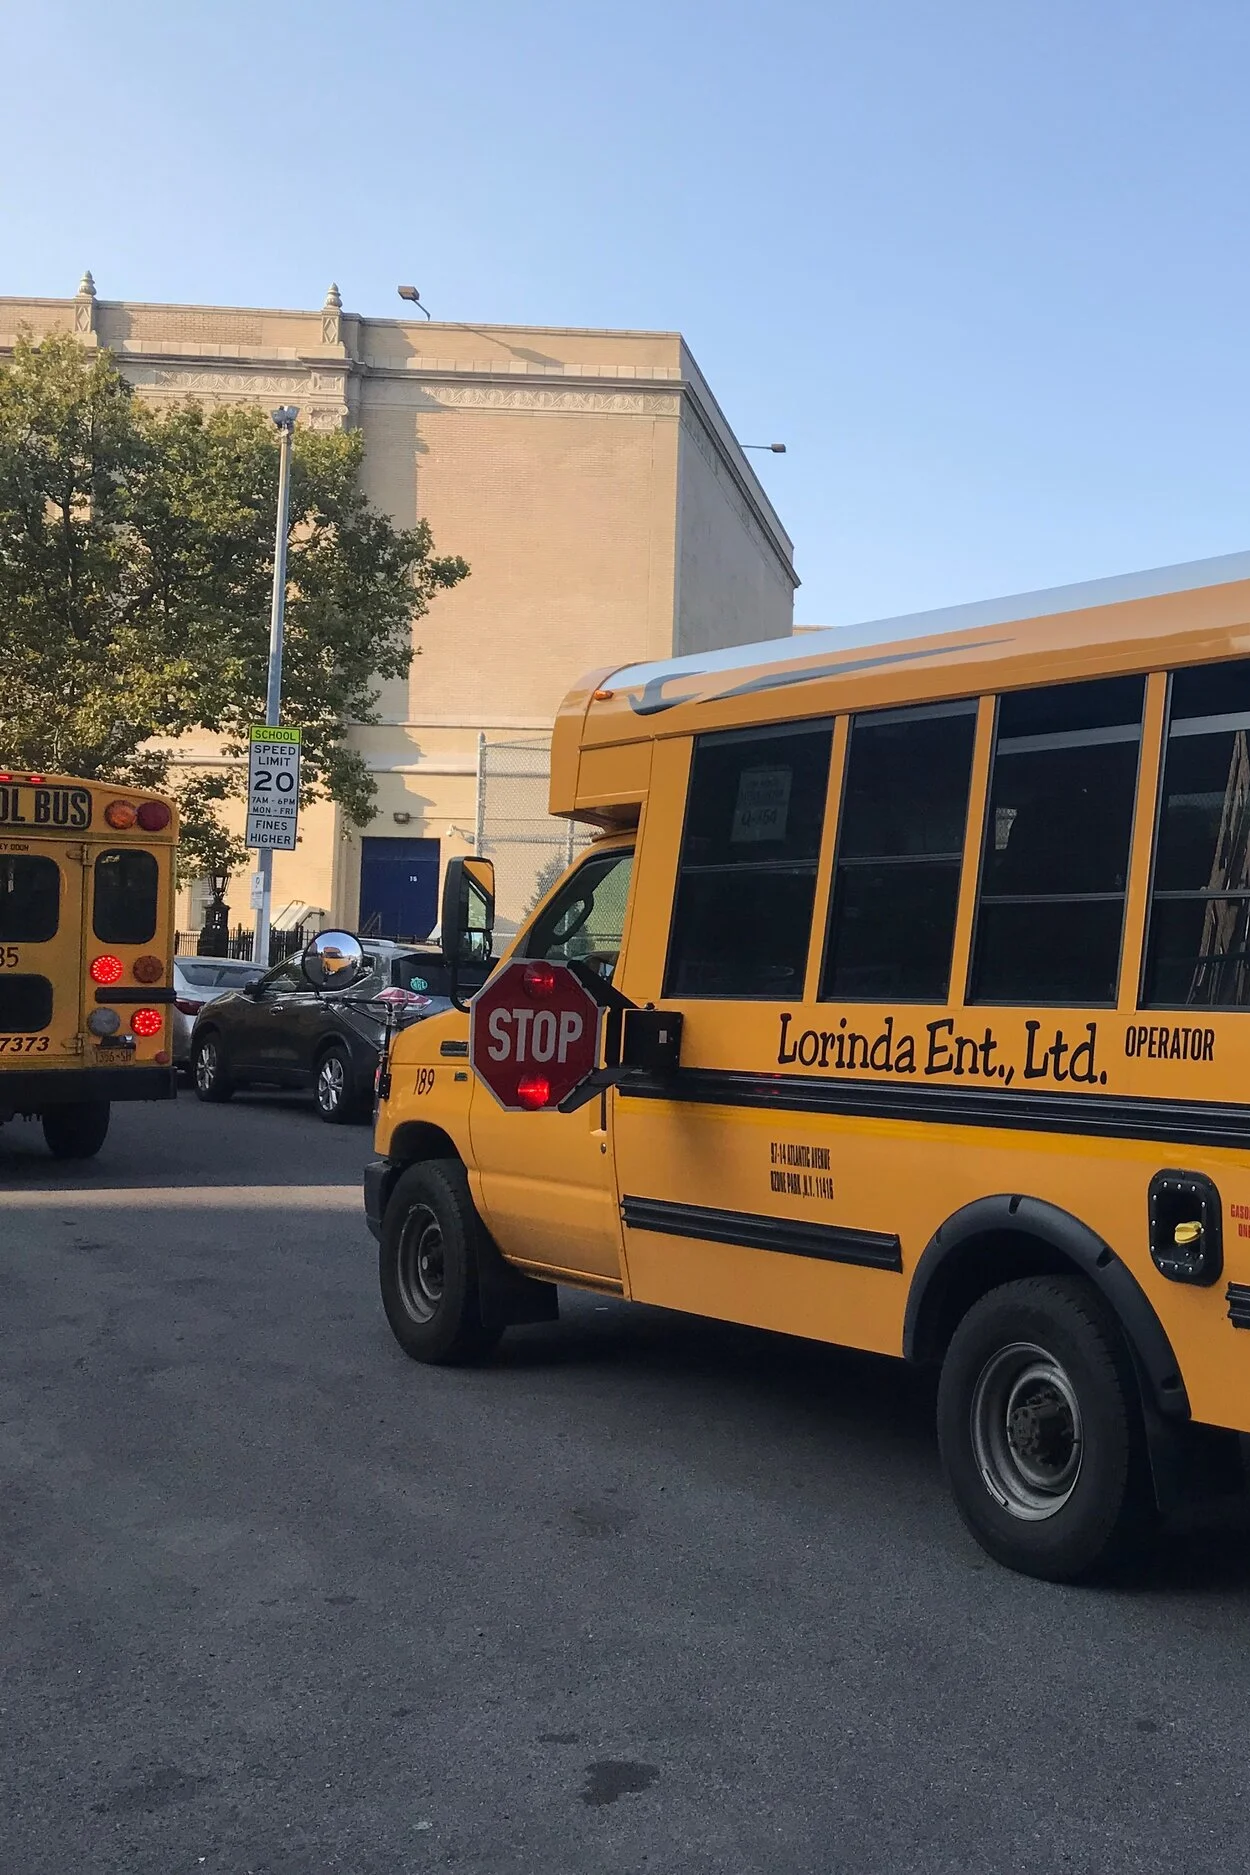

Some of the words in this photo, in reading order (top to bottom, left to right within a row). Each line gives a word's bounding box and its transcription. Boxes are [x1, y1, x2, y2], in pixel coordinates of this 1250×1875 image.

[254, 729, 297, 741] SCHOOL
[253, 744, 296, 756] SPEED
[258, 756, 291, 767] LIMIT
[253, 770, 294, 793] 20
[35, 790, 86, 826] BUS
[251, 796, 269, 804] 7AM
[277, 797, 296, 806] 6PM
[252, 806, 271, 814] MON
[279, 807, 294, 815] FRI
[255, 819, 288, 831] FINES
[249, 833, 291, 845] HIGHER
[487, 1007, 584, 1064] STOP
[0, 1036, 50, 1052] 7373
[777, 1012, 917, 1074] Lorinda
[923, 1017, 1015, 1086] Ent.,
[1023, 1019, 1108, 1085] Ltd.
[1124, 1024, 1216, 1062] OPERATOR
[413, 1068, 435, 1096] 189
[787, 1144, 811, 1168] ATLANTIC
[811, 1146, 831, 1171] AVENUE
[787, 1172, 802, 1195] PARK
